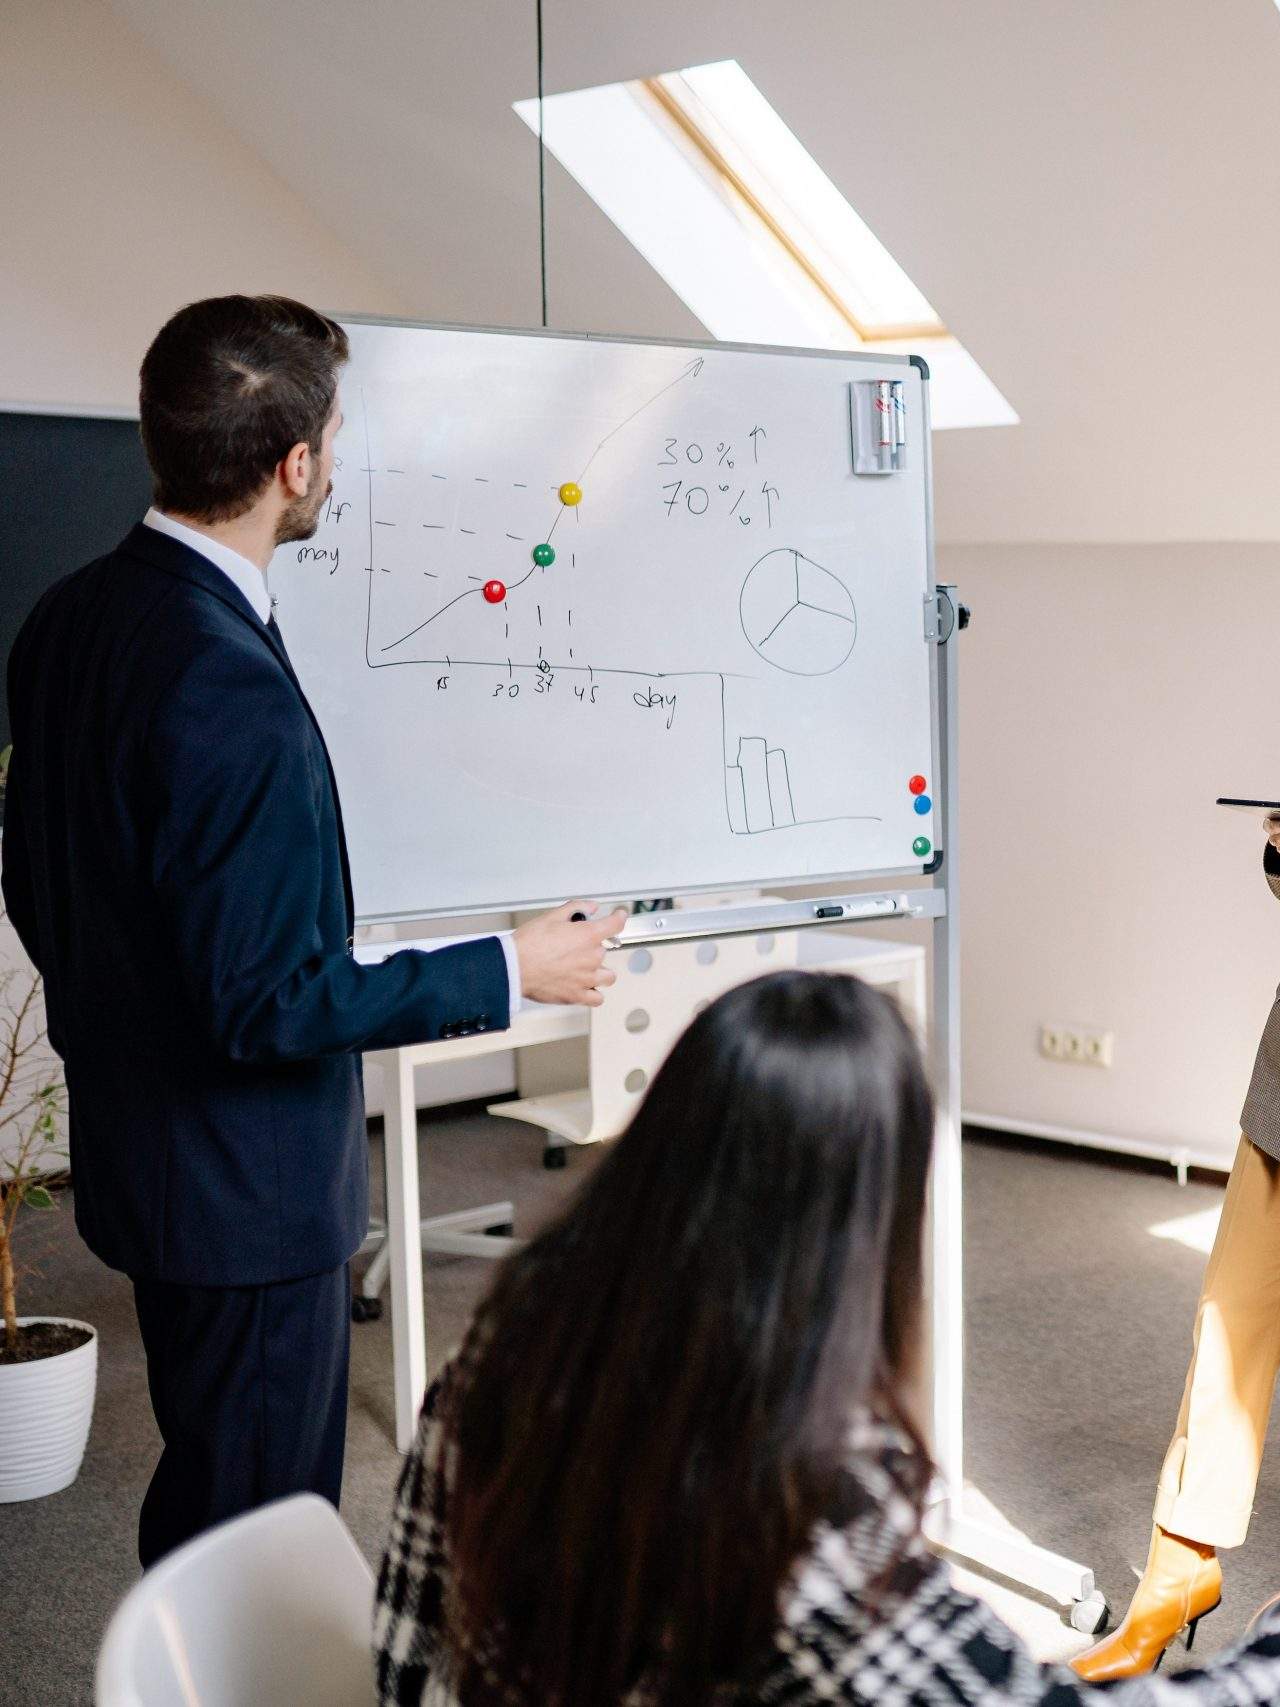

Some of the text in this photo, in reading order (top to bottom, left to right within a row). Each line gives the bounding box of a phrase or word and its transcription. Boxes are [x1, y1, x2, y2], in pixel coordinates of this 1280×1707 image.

[656, 438, 735, 469] 30%
[662, 480, 751, 525] 70%
[492, 684, 520, 698] 30
[574, 685, 599, 704] 45
[633, 686, 677, 729] day
